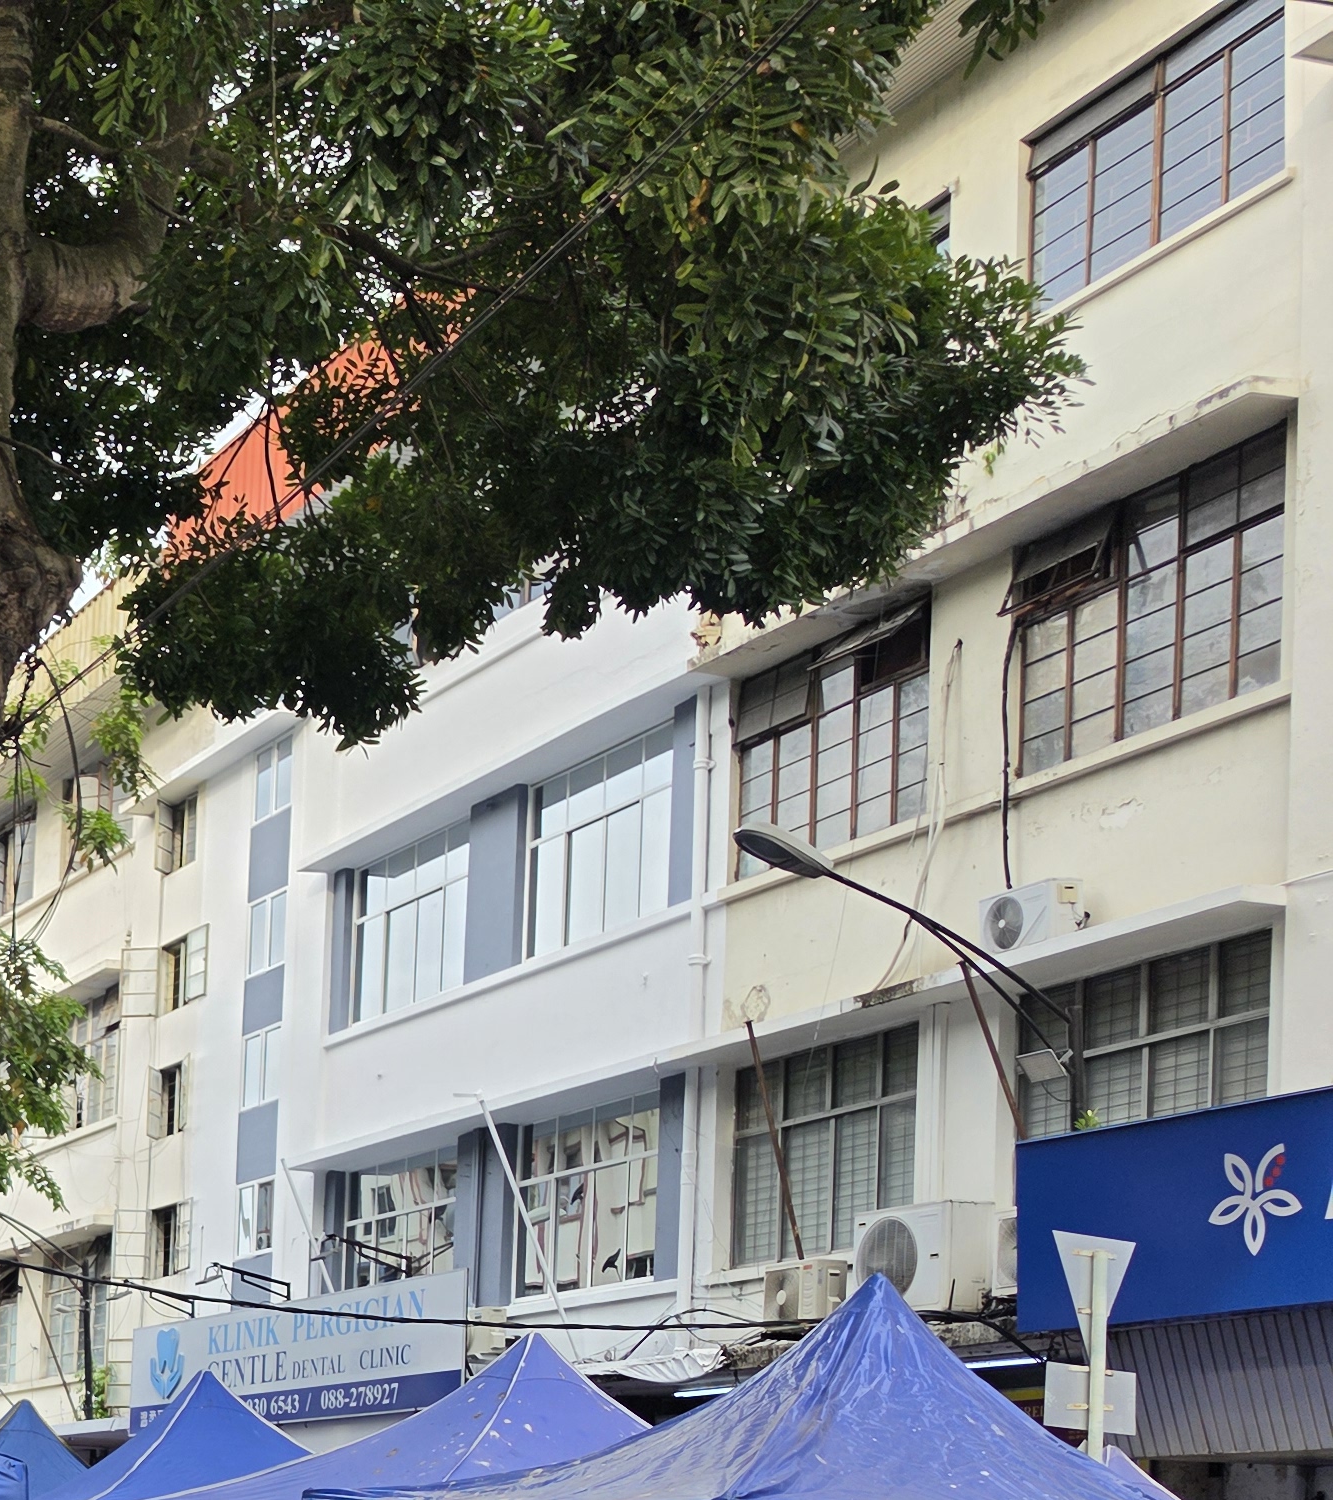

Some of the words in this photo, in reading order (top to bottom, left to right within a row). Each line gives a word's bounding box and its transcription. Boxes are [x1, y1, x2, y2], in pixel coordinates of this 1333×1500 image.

[206, 1314, 281, 1356] KLINIK
[291, 1288, 426, 1343] PERGIGIAN
[292, 1353, 346, 1380] DENTAL
[359, 1344, 412, 1371] CLINIC
[270, 1394, 300, 1416] 6543
[320, 1382, 400, 1410] 088-278927
